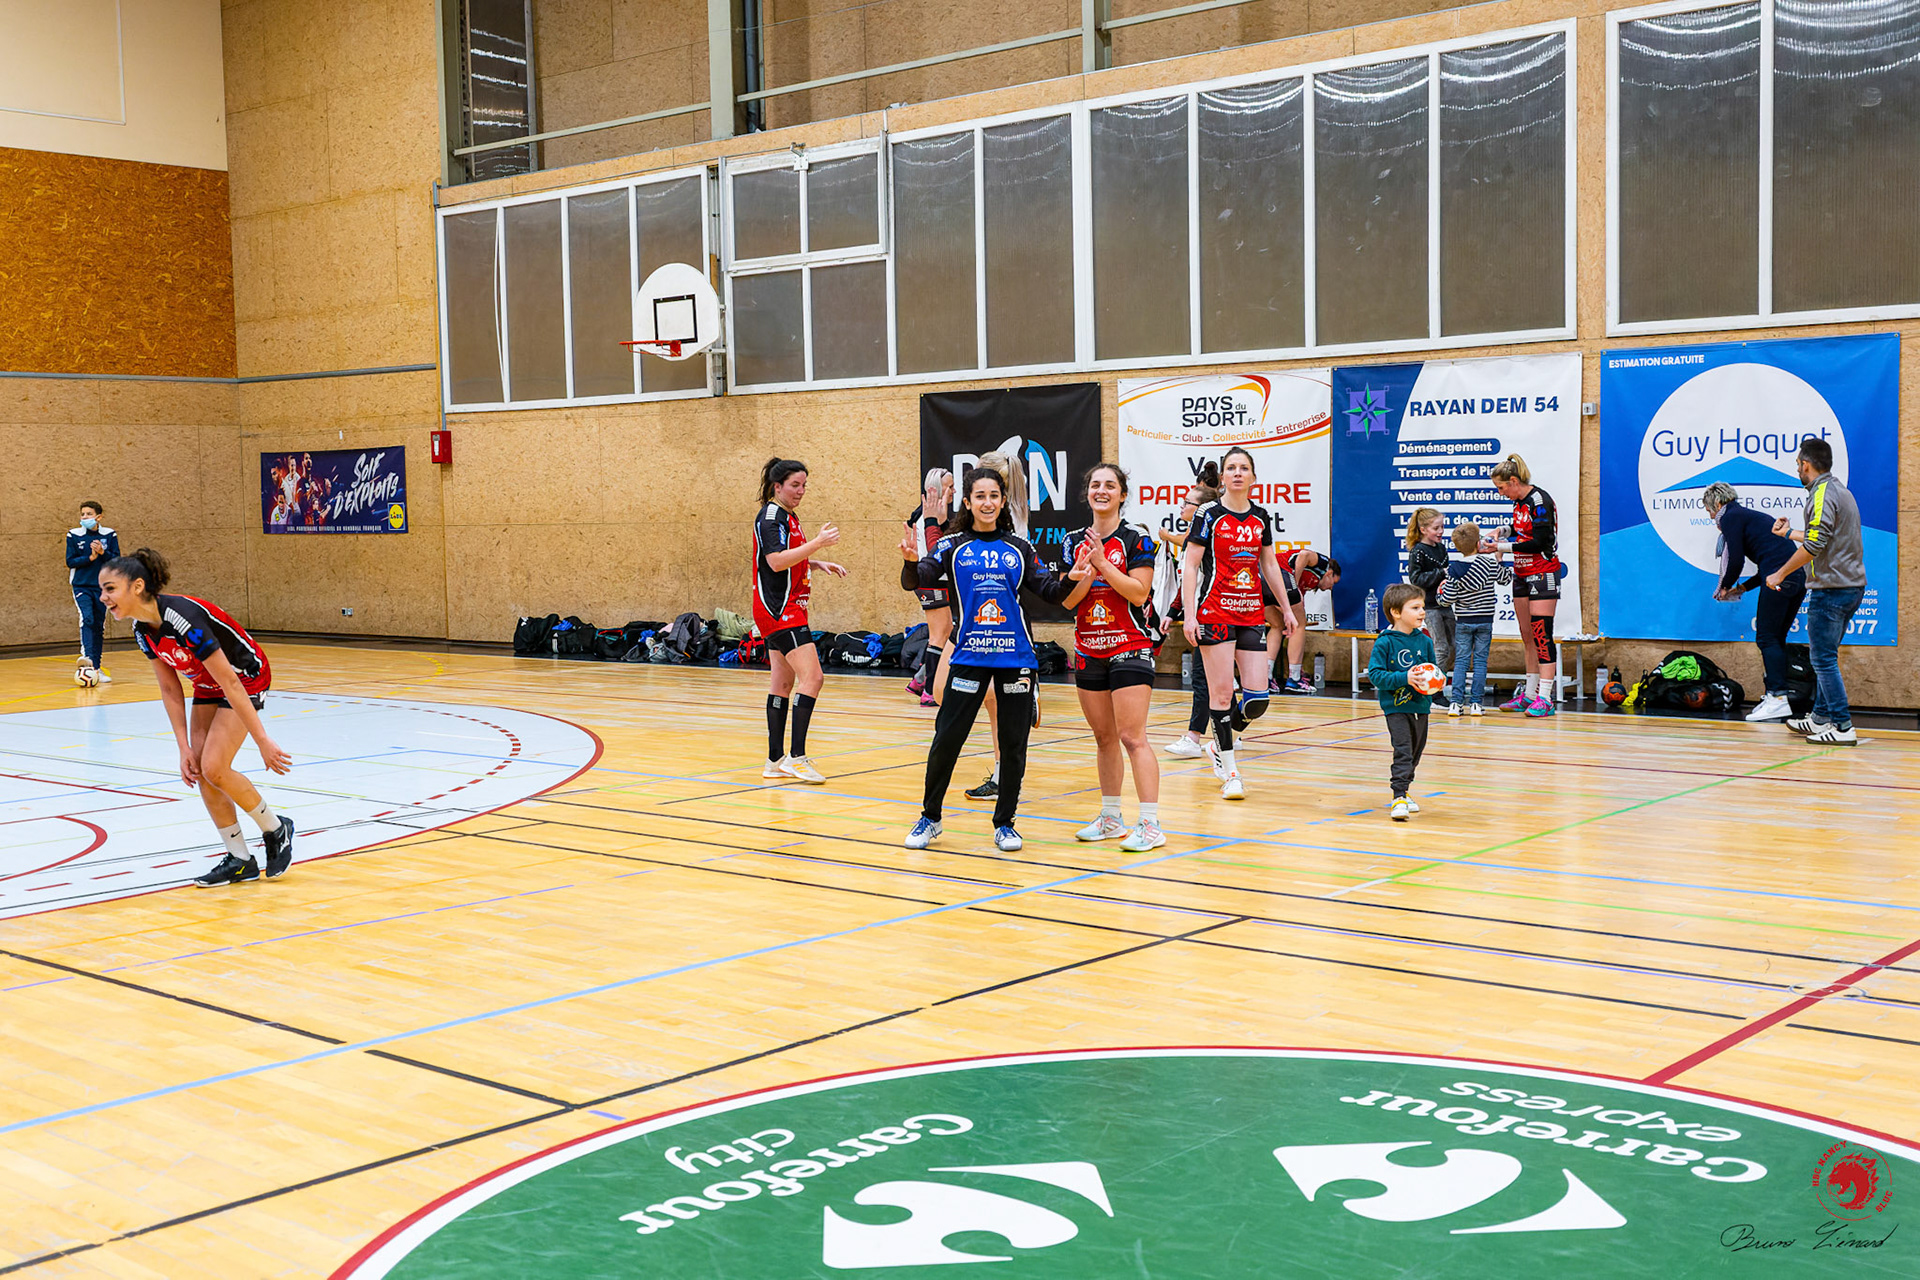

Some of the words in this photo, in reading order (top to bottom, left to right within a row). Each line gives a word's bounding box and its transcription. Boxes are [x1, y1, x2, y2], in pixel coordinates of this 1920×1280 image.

[1609, 356, 1662, 368] ESTIMATION
[1662, 354, 1704, 366] GRATUITE
[1182, 396, 1233, 412] PAYS
[1235, 402, 1246, 410] du
[1410, 398, 1475, 417] RAYAN
[1481, 397, 1527, 414] DEM
[1534, 396, 1560, 412] 54
[1127, 425, 1172, 441] Particulier
[1182, 433, 1203, 442] Club
[1213, 427, 1266, 442] Collectivité
[1276, 411, 1327, 435] Entreprise
[1399, 441, 1492, 455] Déménagement
[1652, 429, 1710, 462] Guy
[1398, 466, 1457, 479] Transport
[1460, 465, 1476, 476] de
[1139, 483, 1312, 505] PARAIRE
[1398, 491, 1433, 502] Vente
[1435, 490, 1451, 501] de
[1760, 496, 1808, 509] GARA
[1453, 515, 1469, 525] de
[980, 550, 999, 568] 12
[965, 637, 1016, 648] OMPTOIR
[1440, 1081, 1742, 1142] express
[1339, 1089, 1768, 1183] Carrefour
[619, 1113, 974, 1235] Carrefour
